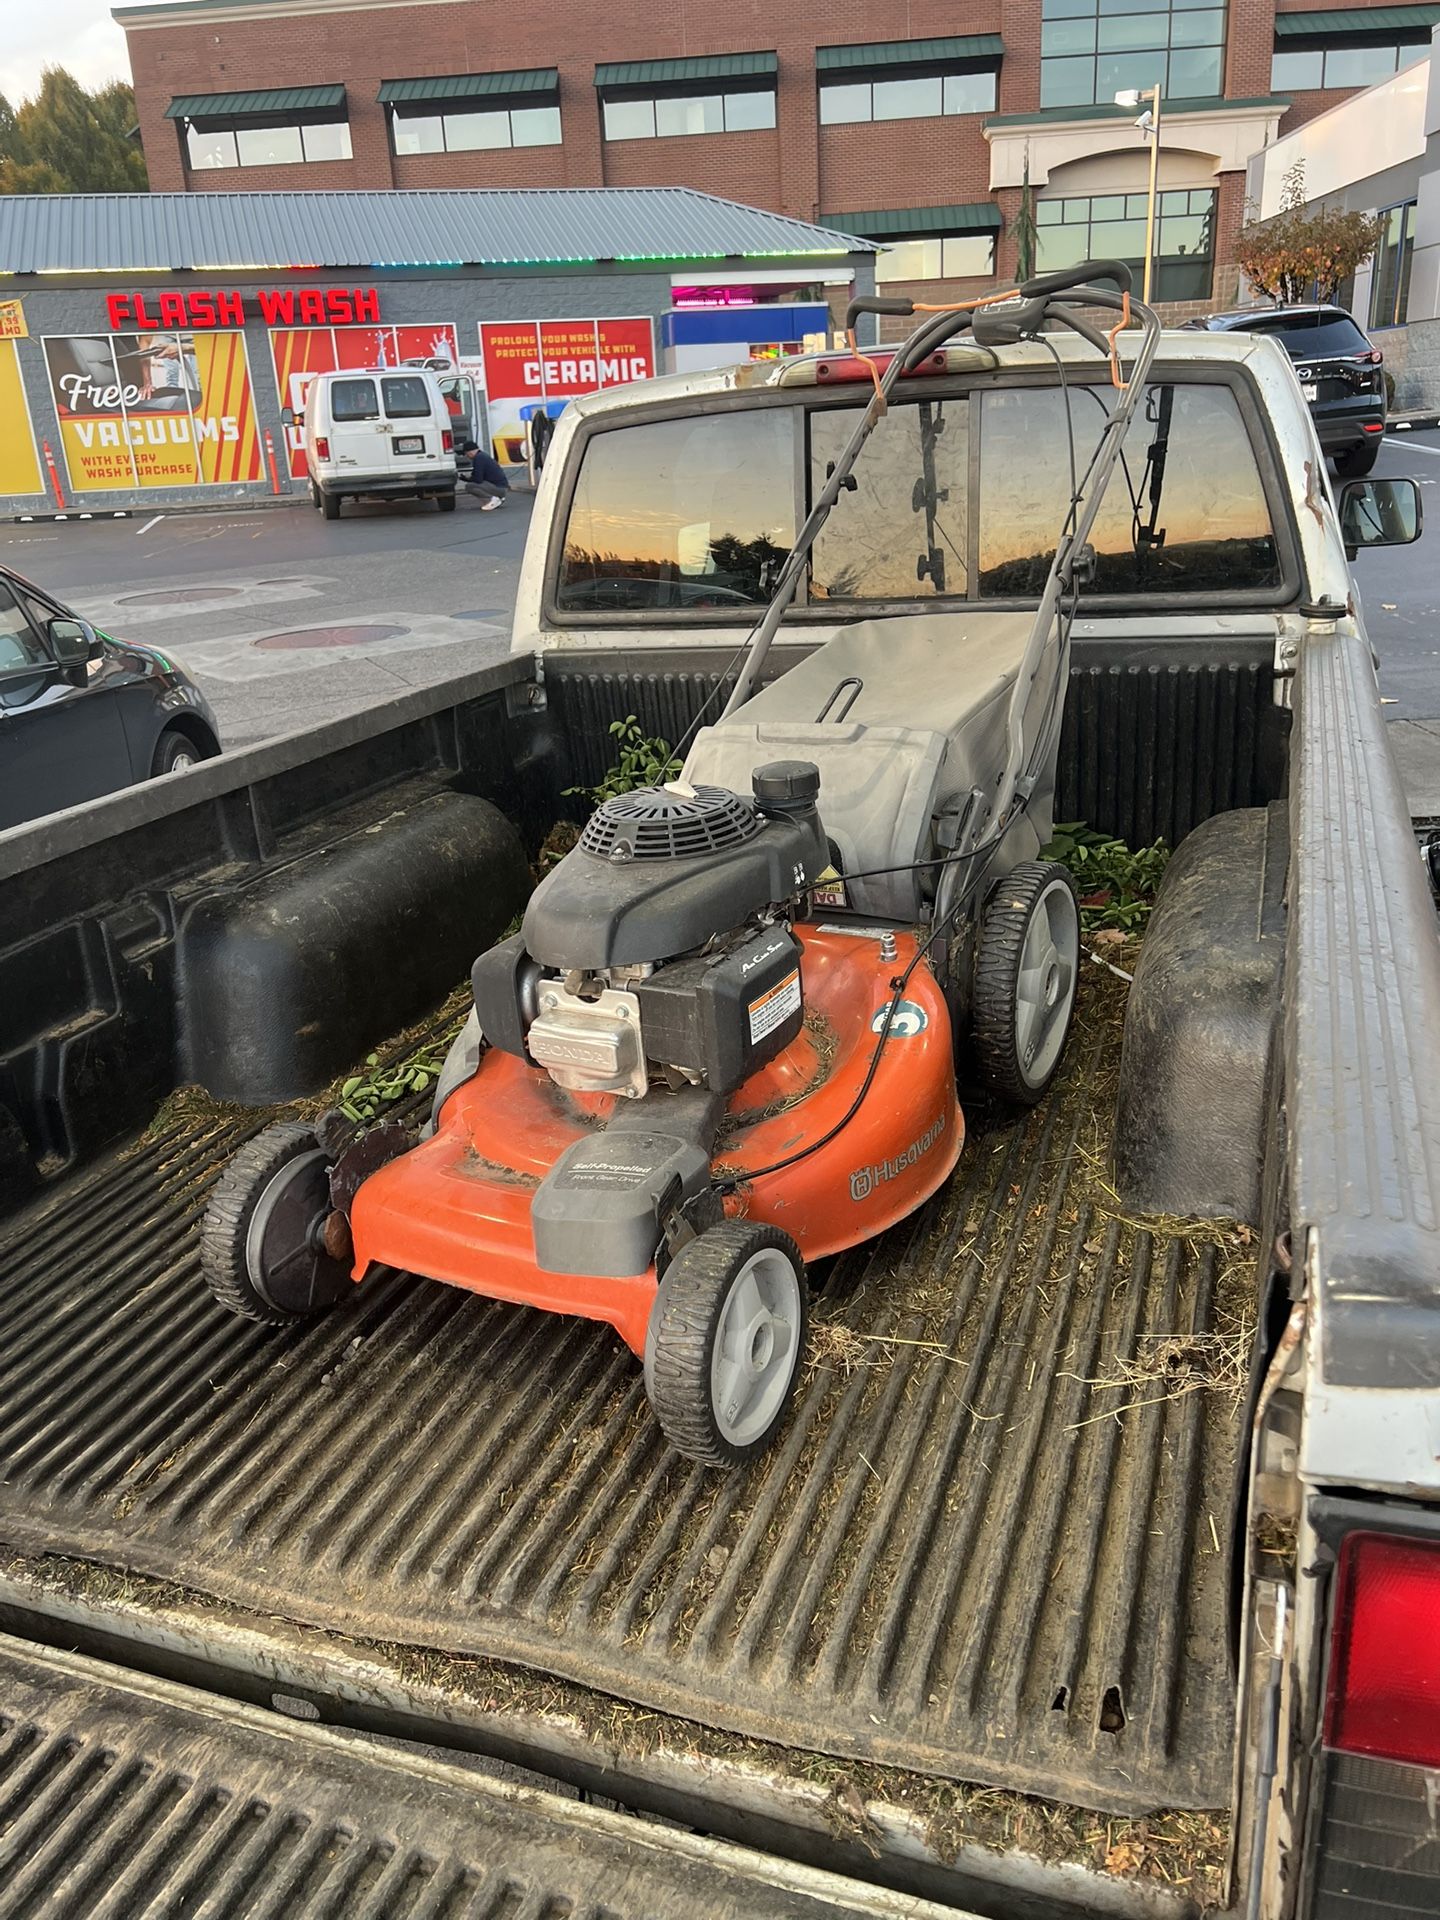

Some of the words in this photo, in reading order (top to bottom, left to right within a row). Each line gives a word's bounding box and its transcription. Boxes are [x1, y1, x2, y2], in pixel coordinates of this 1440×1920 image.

[106, 291, 245, 330] FLASH
[257, 288, 381, 325] WASH
[490, 336, 536, 346] PROLONG
[541, 334, 567, 344] YOUR
[568, 333, 596, 343] WASH
[495, 348, 539, 358] PROTECT
[542, 347, 569, 356] YOUR
[571, 345, 611, 355] VEHICLE
[612, 344, 636, 353] WITH
[523, 357, 647, 385] CERAMIC
[59, 373, 142, 411] Free
[73, 416, 240, 448] VACUUMS
[81, 456, 112, 466] WITH
[116, 453, 157, 465] EVERY
[86, 466, 122, 478] WASH
[126, 464, 193, 477] PURCHASE
[533, 1041, 610, 1064] HONDA
[874, 1113, 945, 1187] Husqvarna
[572, 1162, 652, 1173] Self-Propelled
